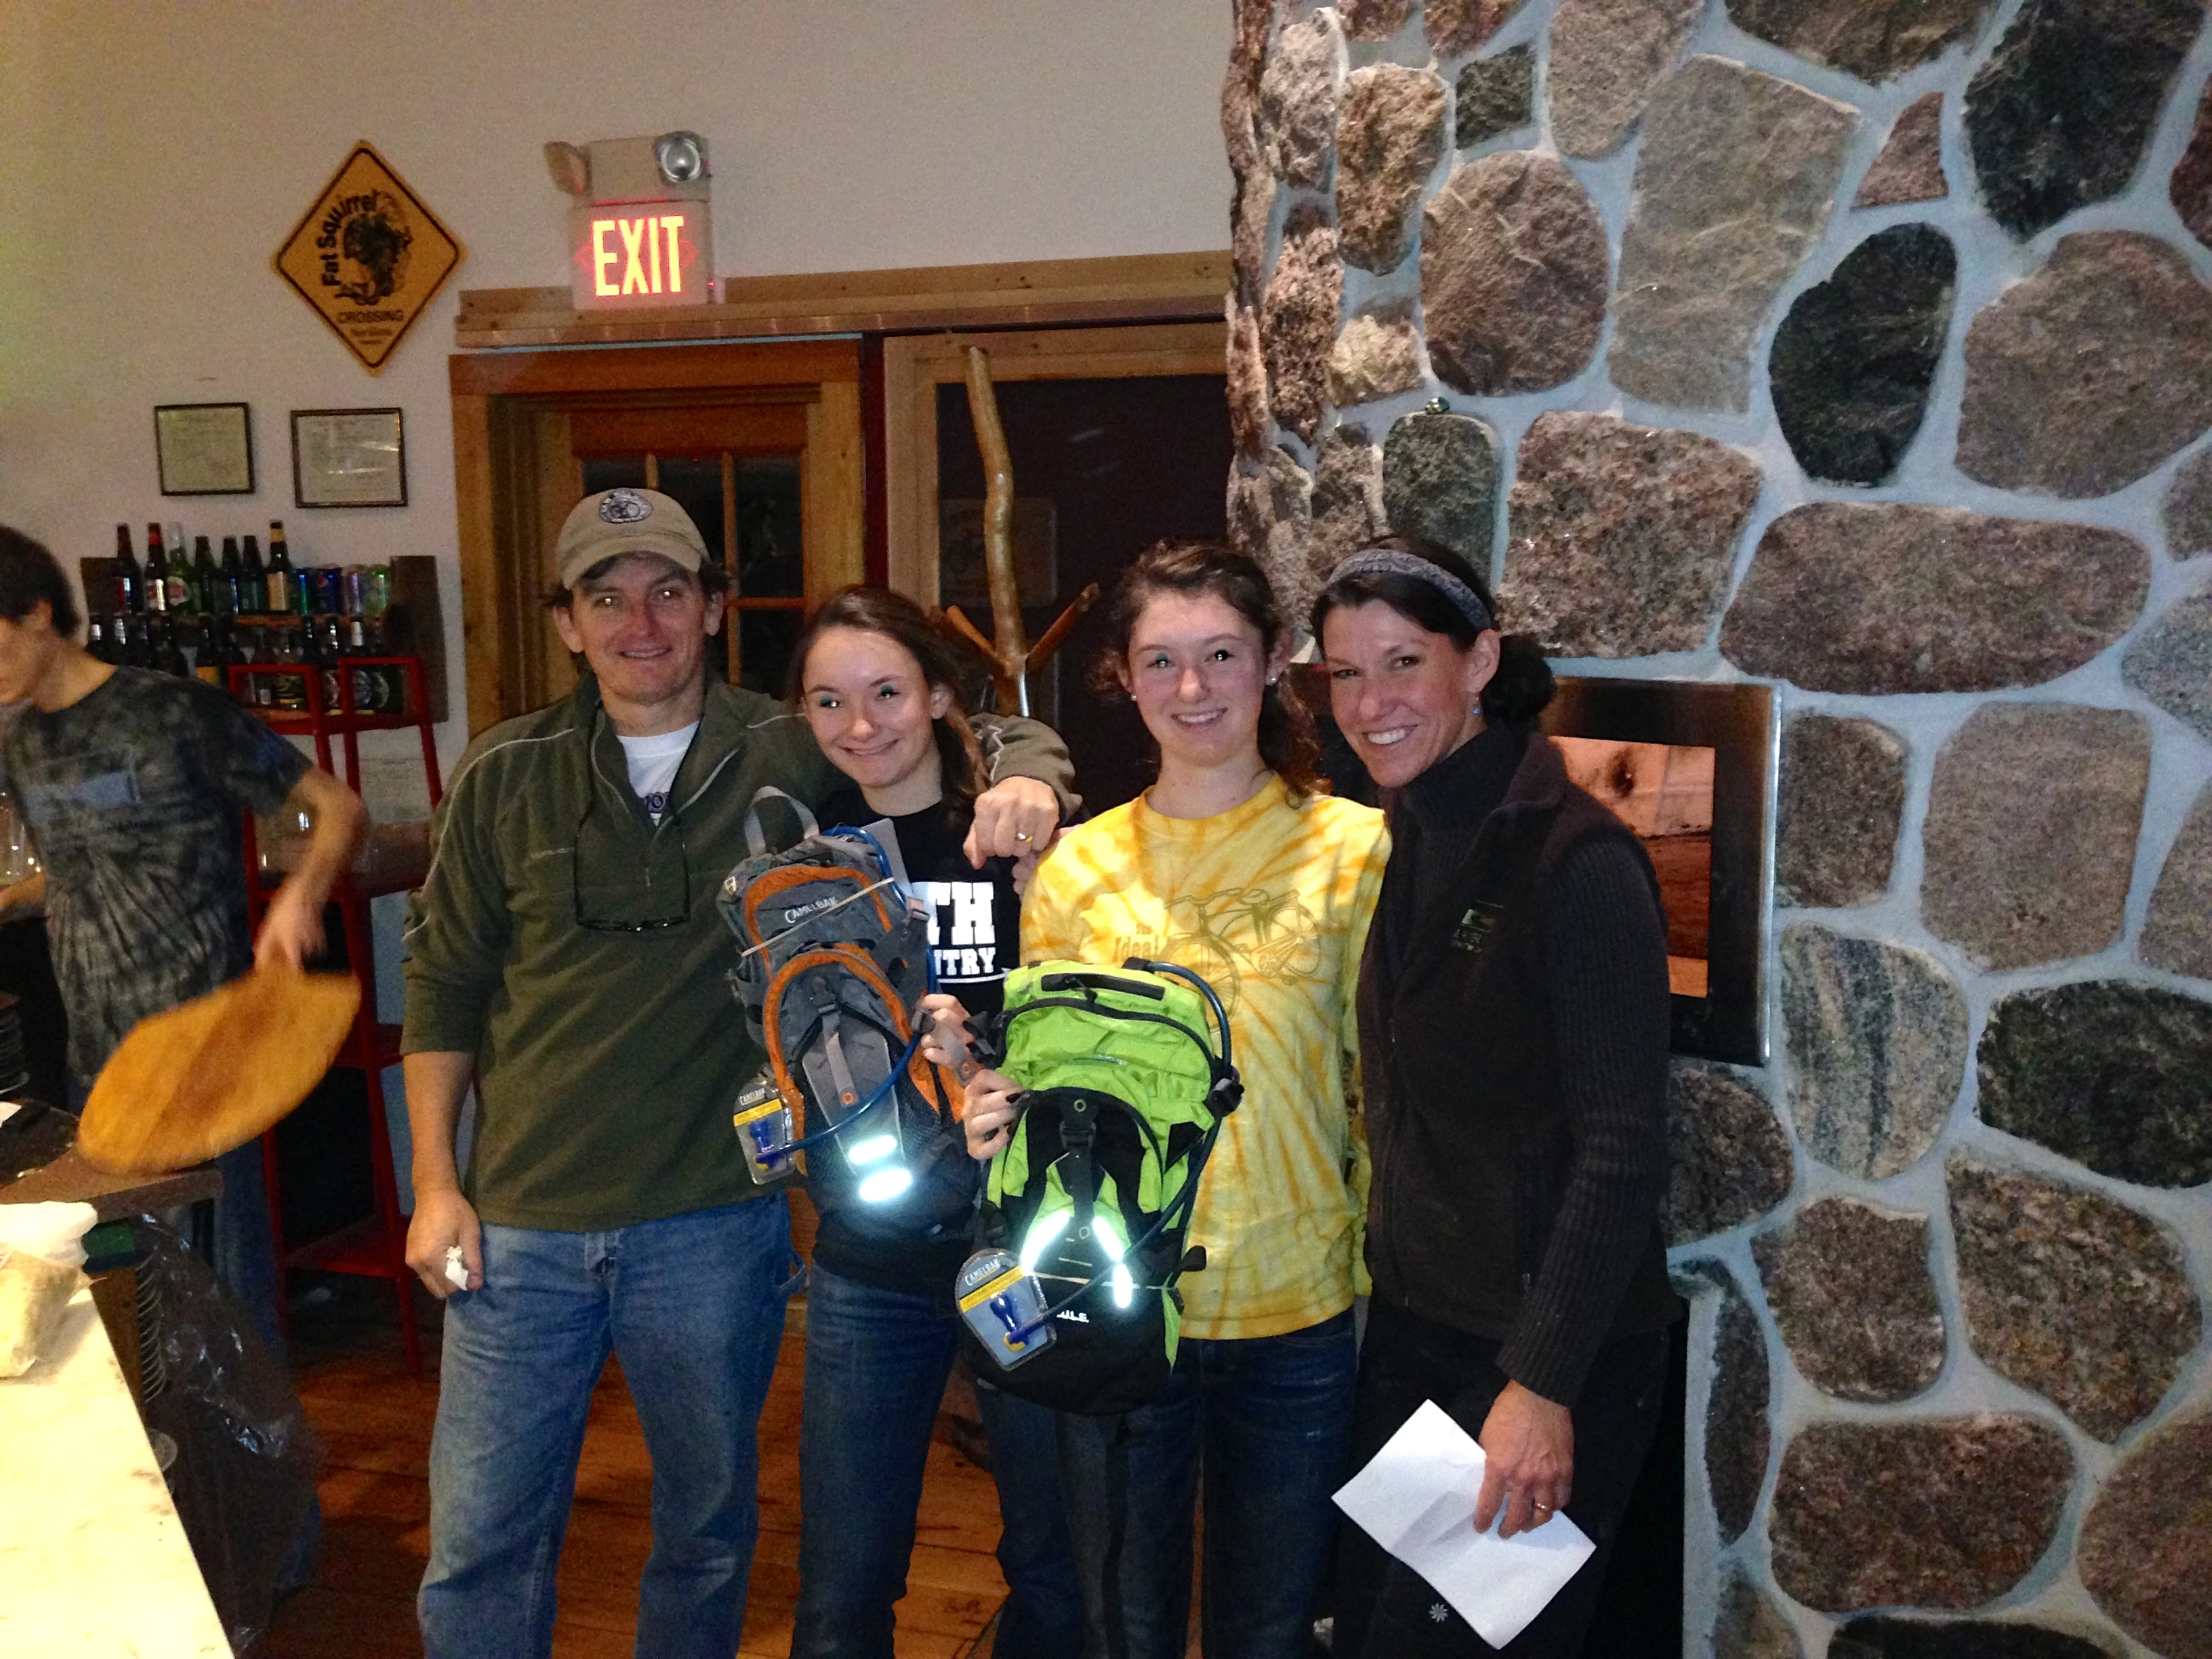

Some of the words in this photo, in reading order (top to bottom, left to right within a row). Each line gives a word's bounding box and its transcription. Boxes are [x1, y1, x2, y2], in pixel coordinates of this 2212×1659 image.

[316, 188, 378, 249] Squirrel
[321, 253, 341, 286] Fat
[592, 216, 684, 296] EXIT
[338, 309, 405, 324] CROSSING
[785, 897, 838, 924] CAMELBAK
[964, 1258, 1001, 1286] CAMELBAK
